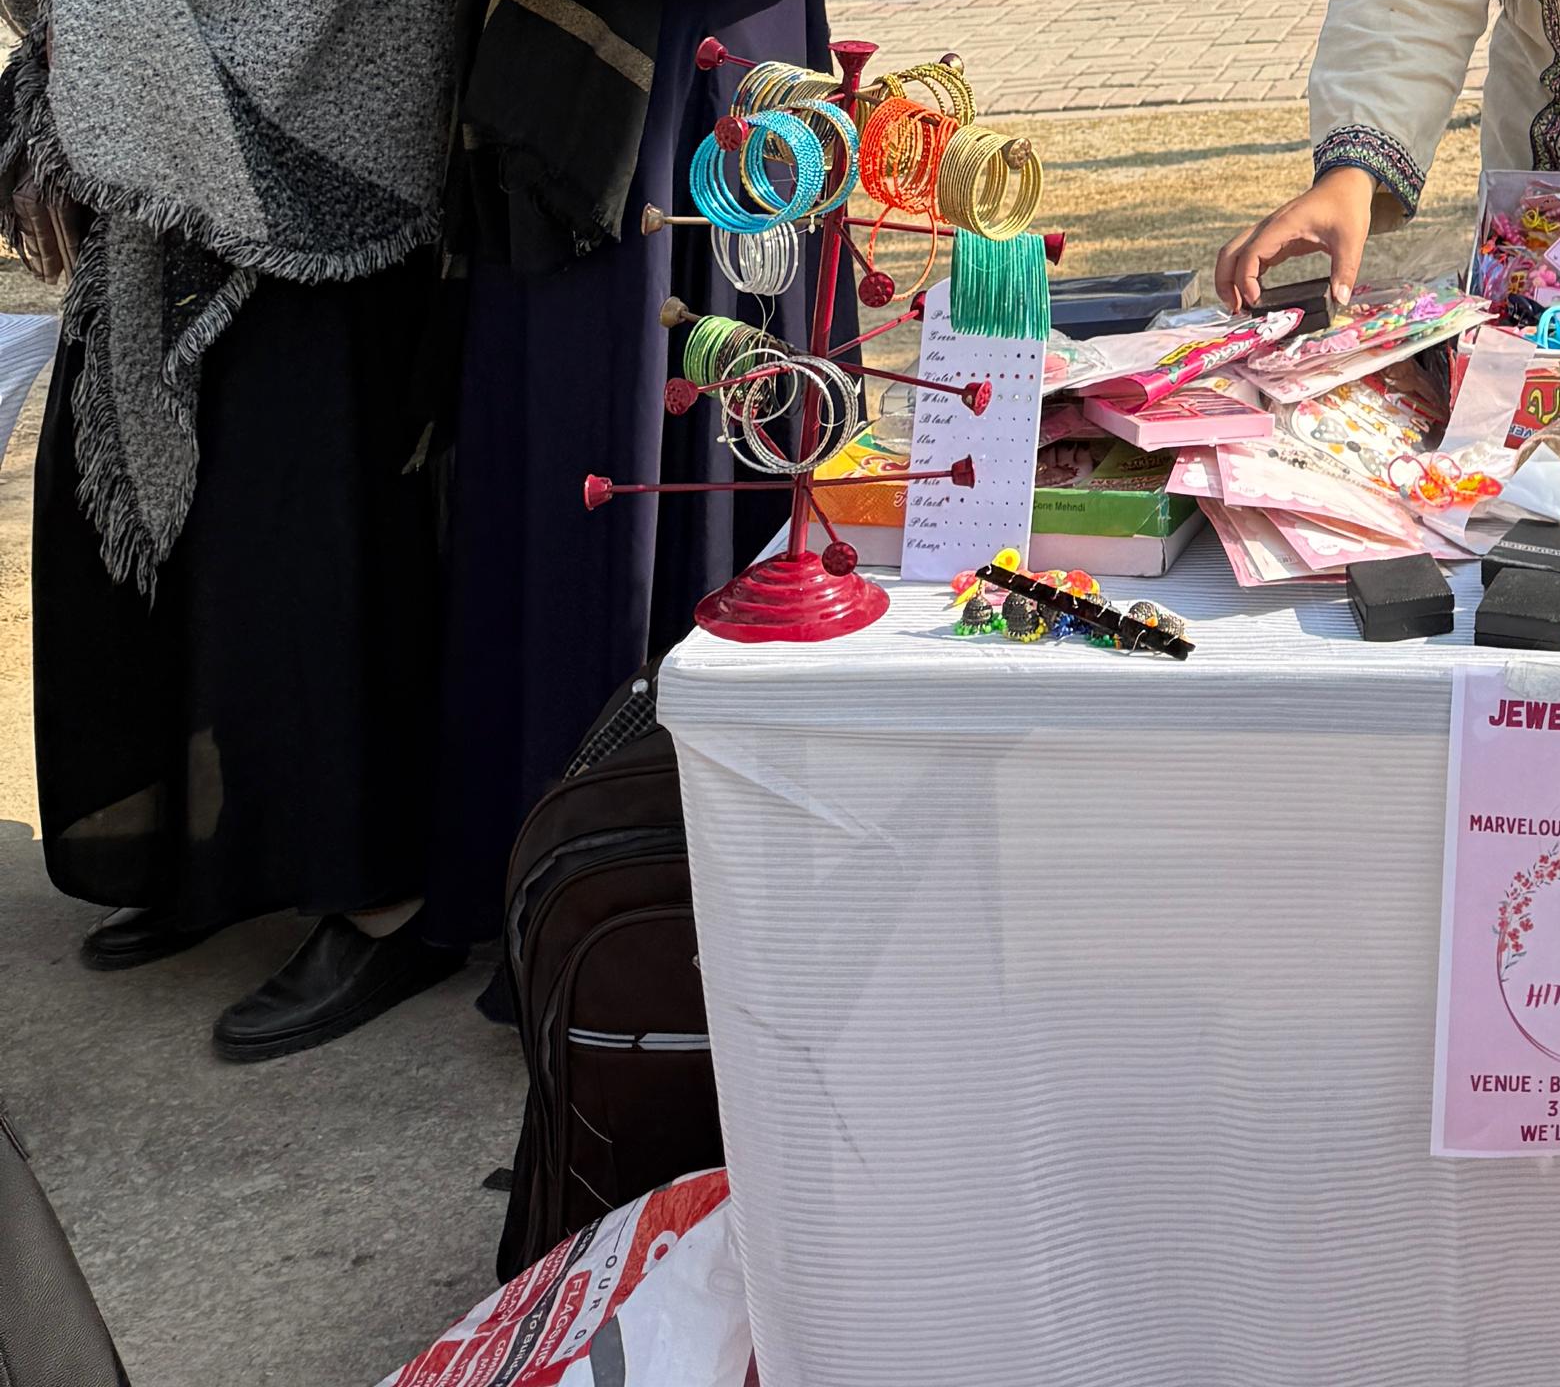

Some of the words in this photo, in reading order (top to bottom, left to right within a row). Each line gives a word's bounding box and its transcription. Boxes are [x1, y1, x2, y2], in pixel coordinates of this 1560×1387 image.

[928, 330, 957, 342] Green
[926, 349, 945, 362] blue
[923, 370, 954, 383] Violet
[921, 391, 950, 404] White
[919, 413, 952, 425] Black
[916, 432, 936, 445] blue
[914, 455, 931, 466] red
[910, 495, 944, 508] Black
[1055, 501, 1086, 513] Mehndi
[908, 516, 938, 529] Plum
[906, 537, 941, 552] Champ
[1470, 1074, 1532, 1093] VENUE
[1547, 1100, 1559, 1117] 3
